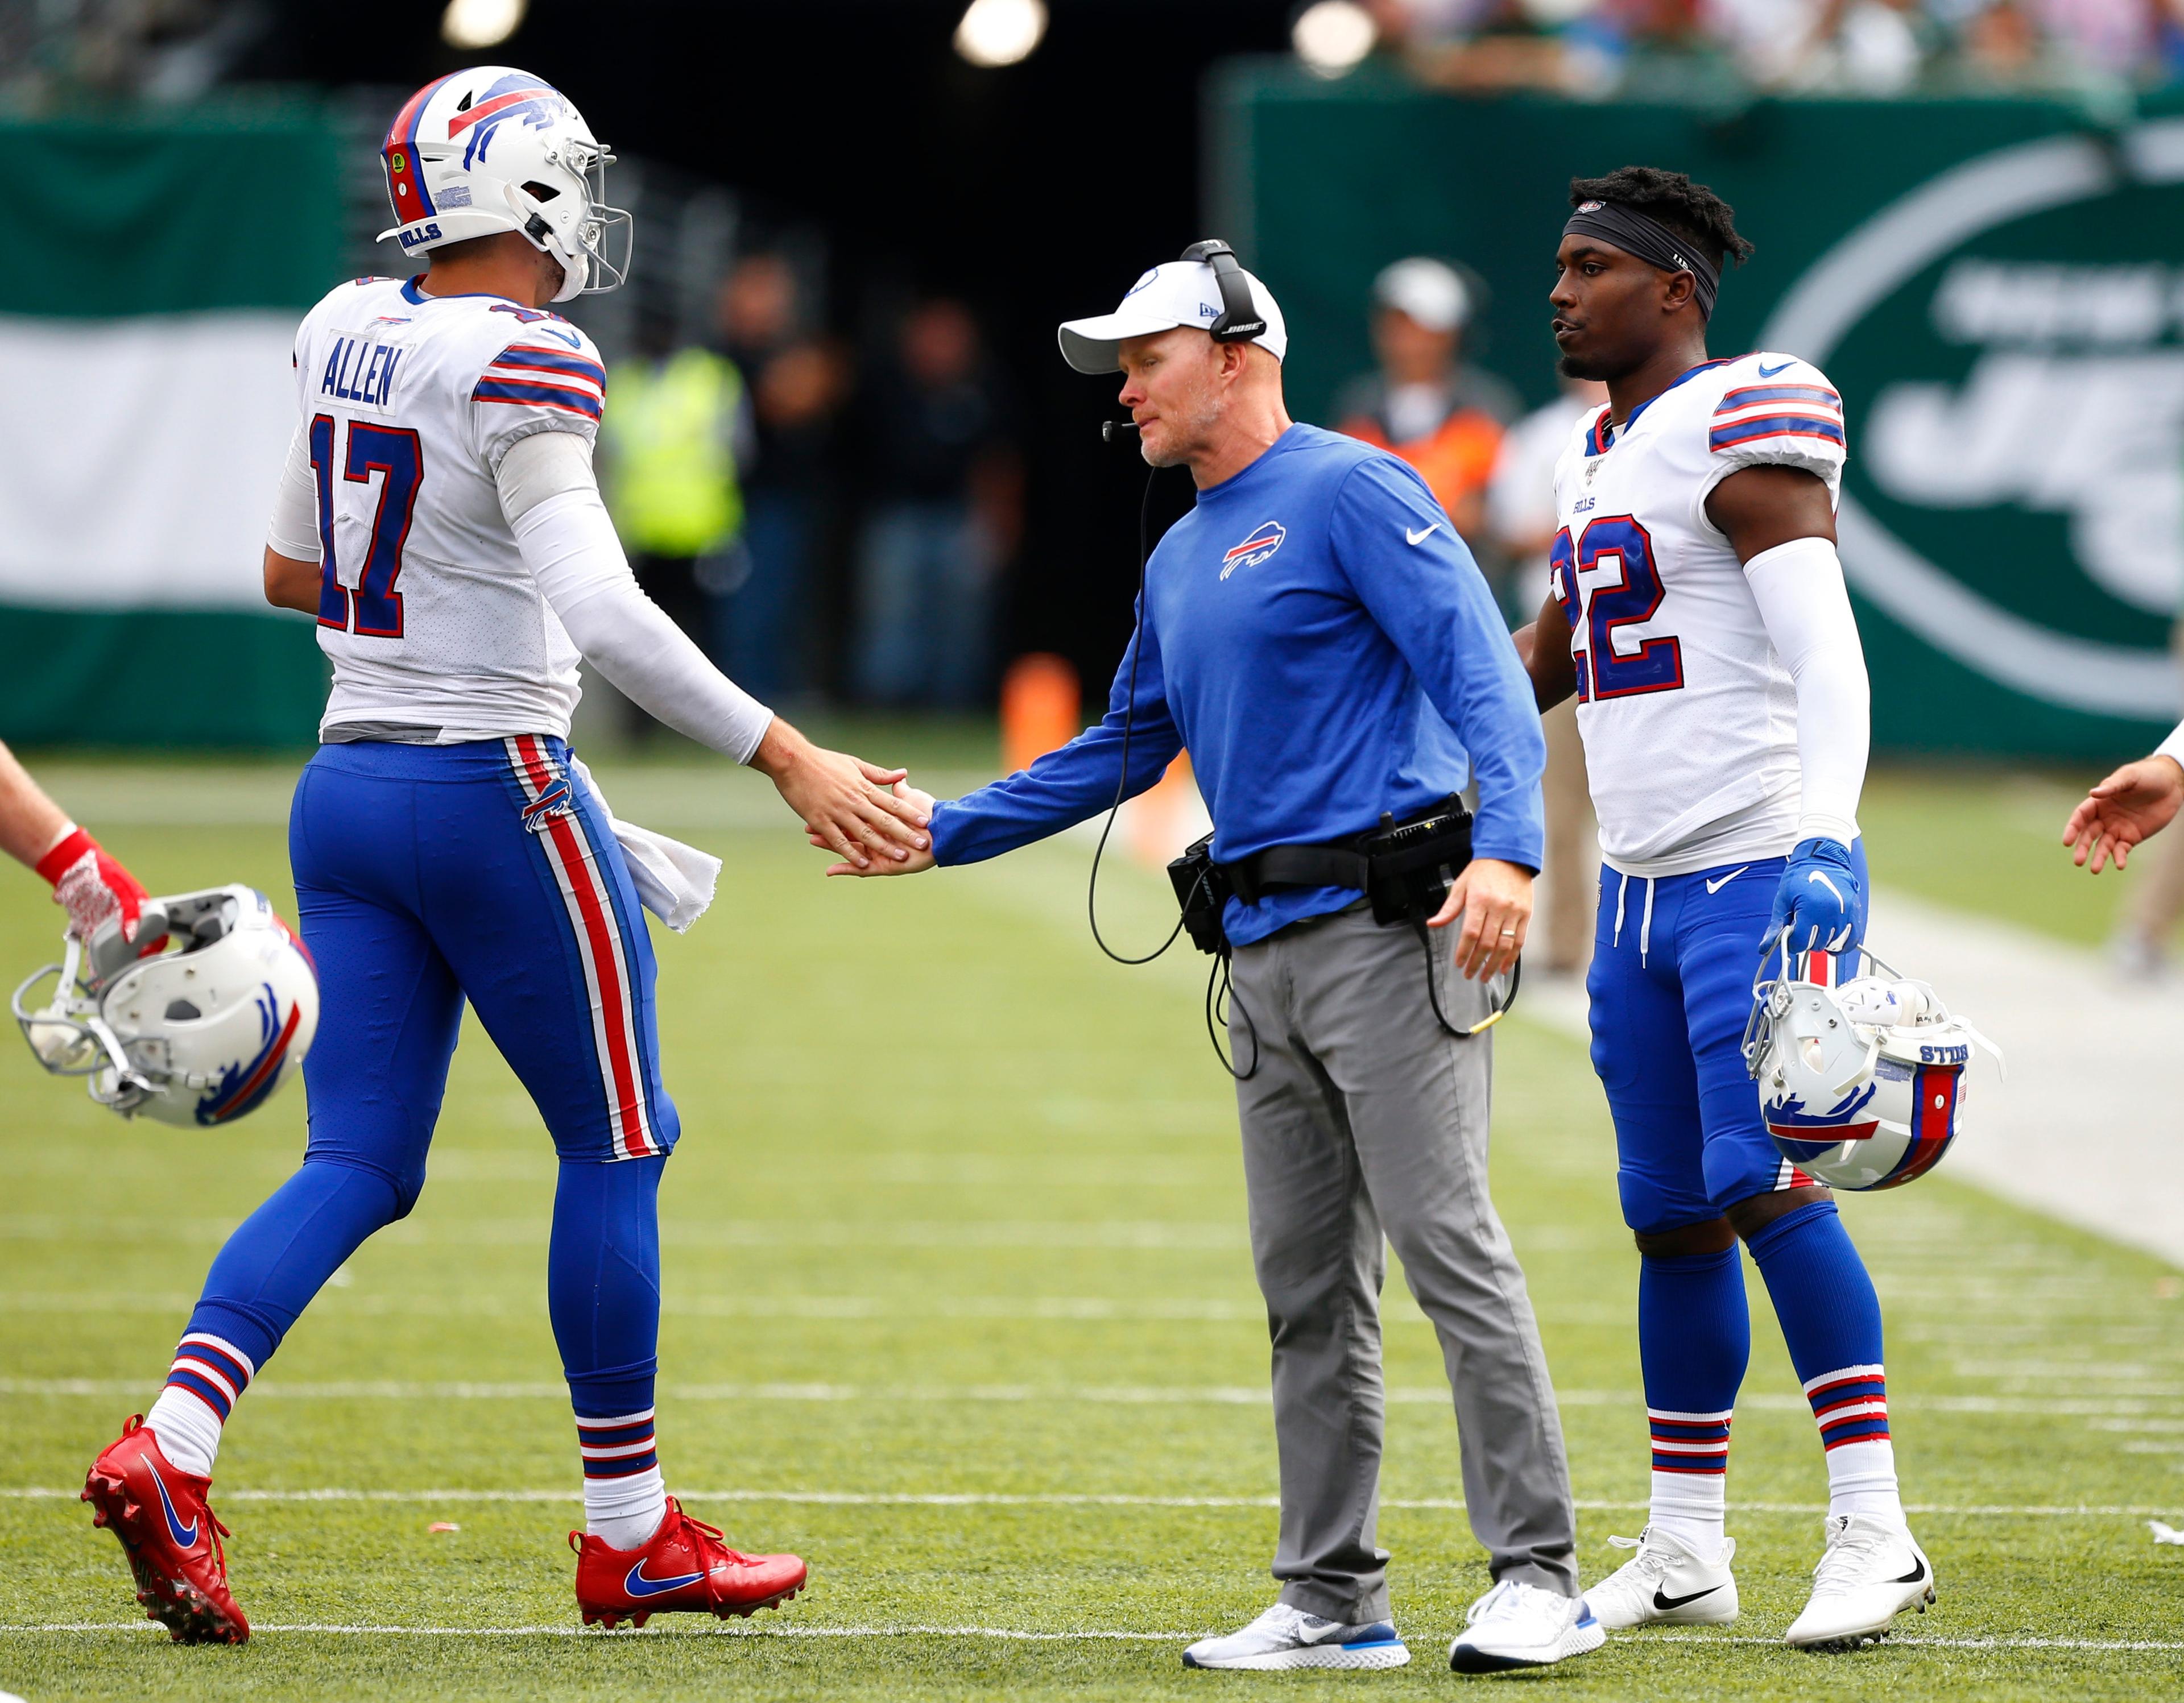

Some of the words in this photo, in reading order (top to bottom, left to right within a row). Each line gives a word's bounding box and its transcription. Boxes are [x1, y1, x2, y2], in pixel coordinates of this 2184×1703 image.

[1221, 321, 1264, 335] BOSE
[321, 337, 403, 405] ALLEN
[1573, 496, 1596, 515] BILLS
[309, 413, 424, 639] 17
[1920, 1043, 1970, 1064] BILLS
